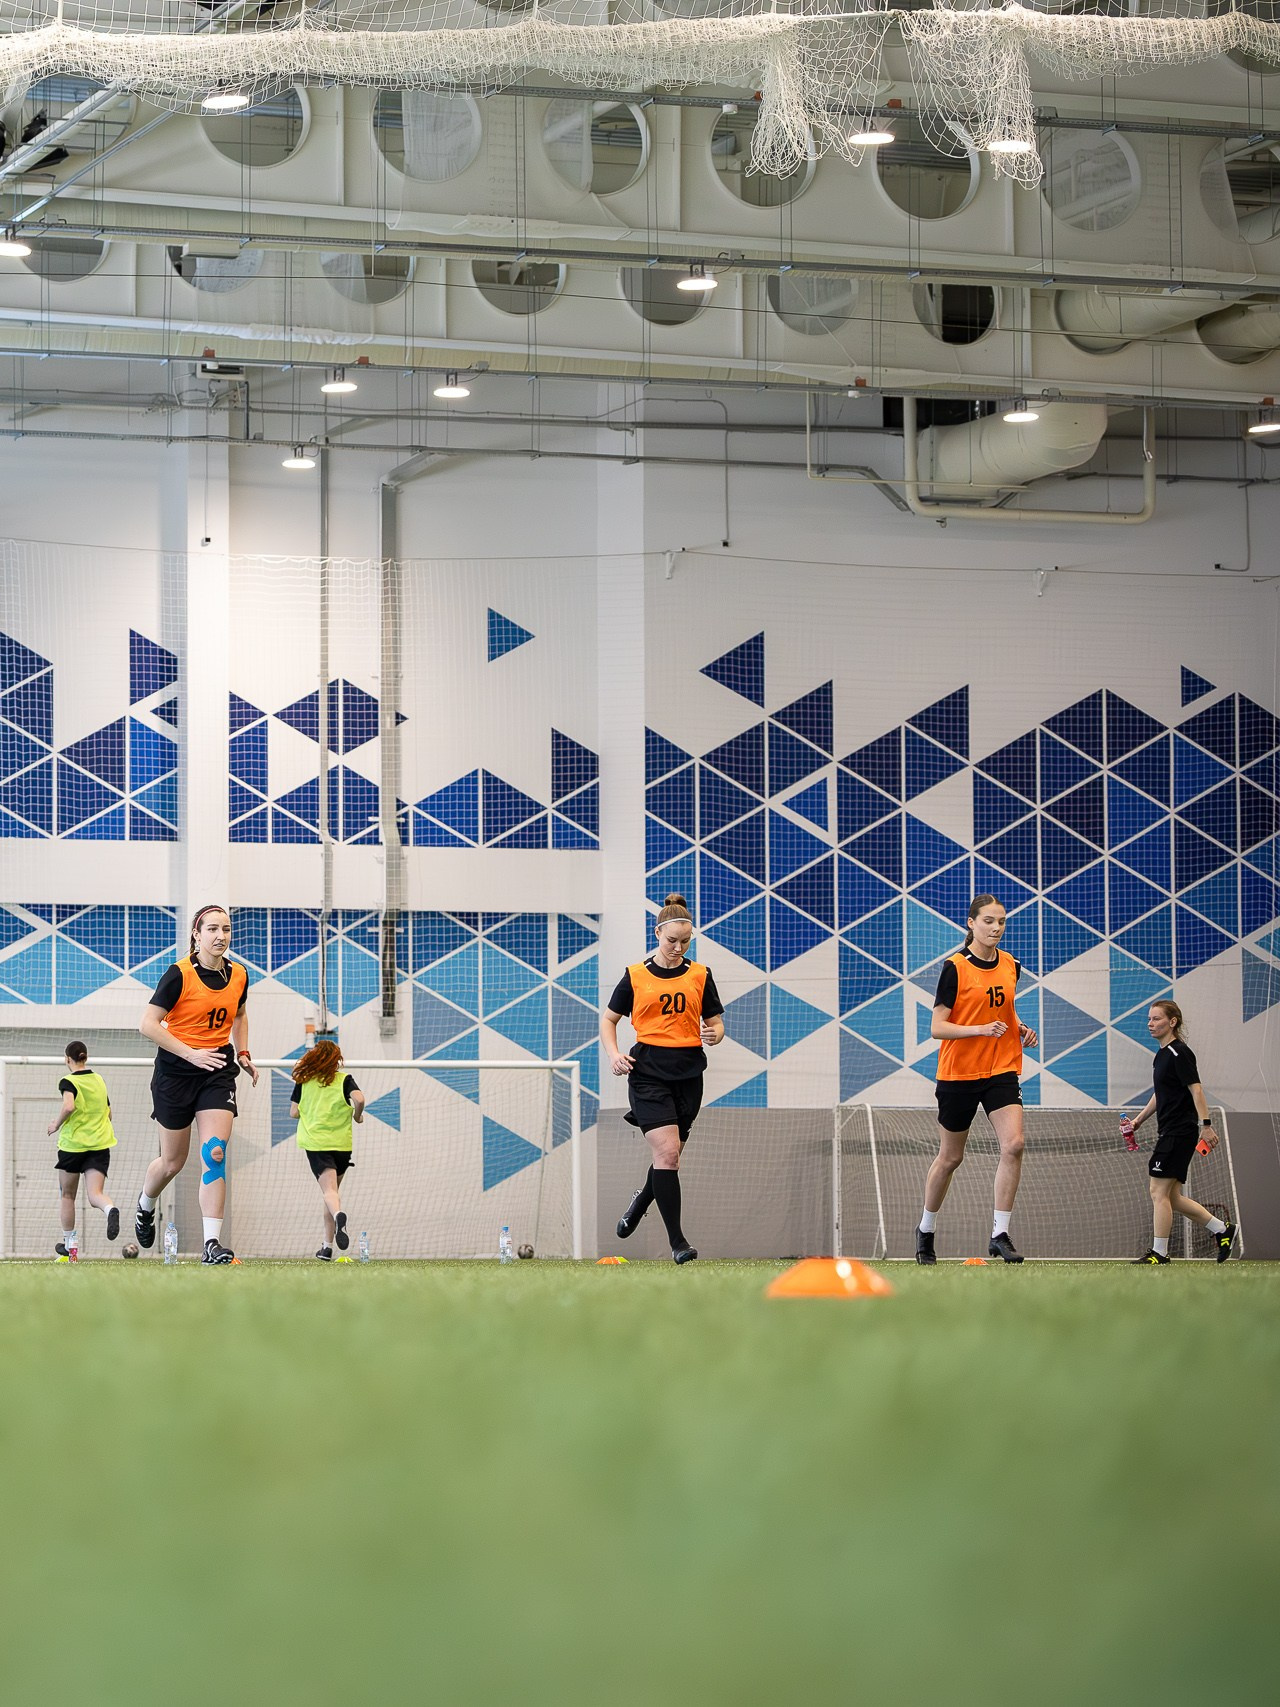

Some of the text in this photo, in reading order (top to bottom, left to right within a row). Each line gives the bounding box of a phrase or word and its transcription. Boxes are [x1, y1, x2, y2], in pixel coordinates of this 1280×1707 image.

[659, 992, 686, 1015] 20
[986, 985, 1006, 1008] 15
[207, 1007, 229, 1030] 19
